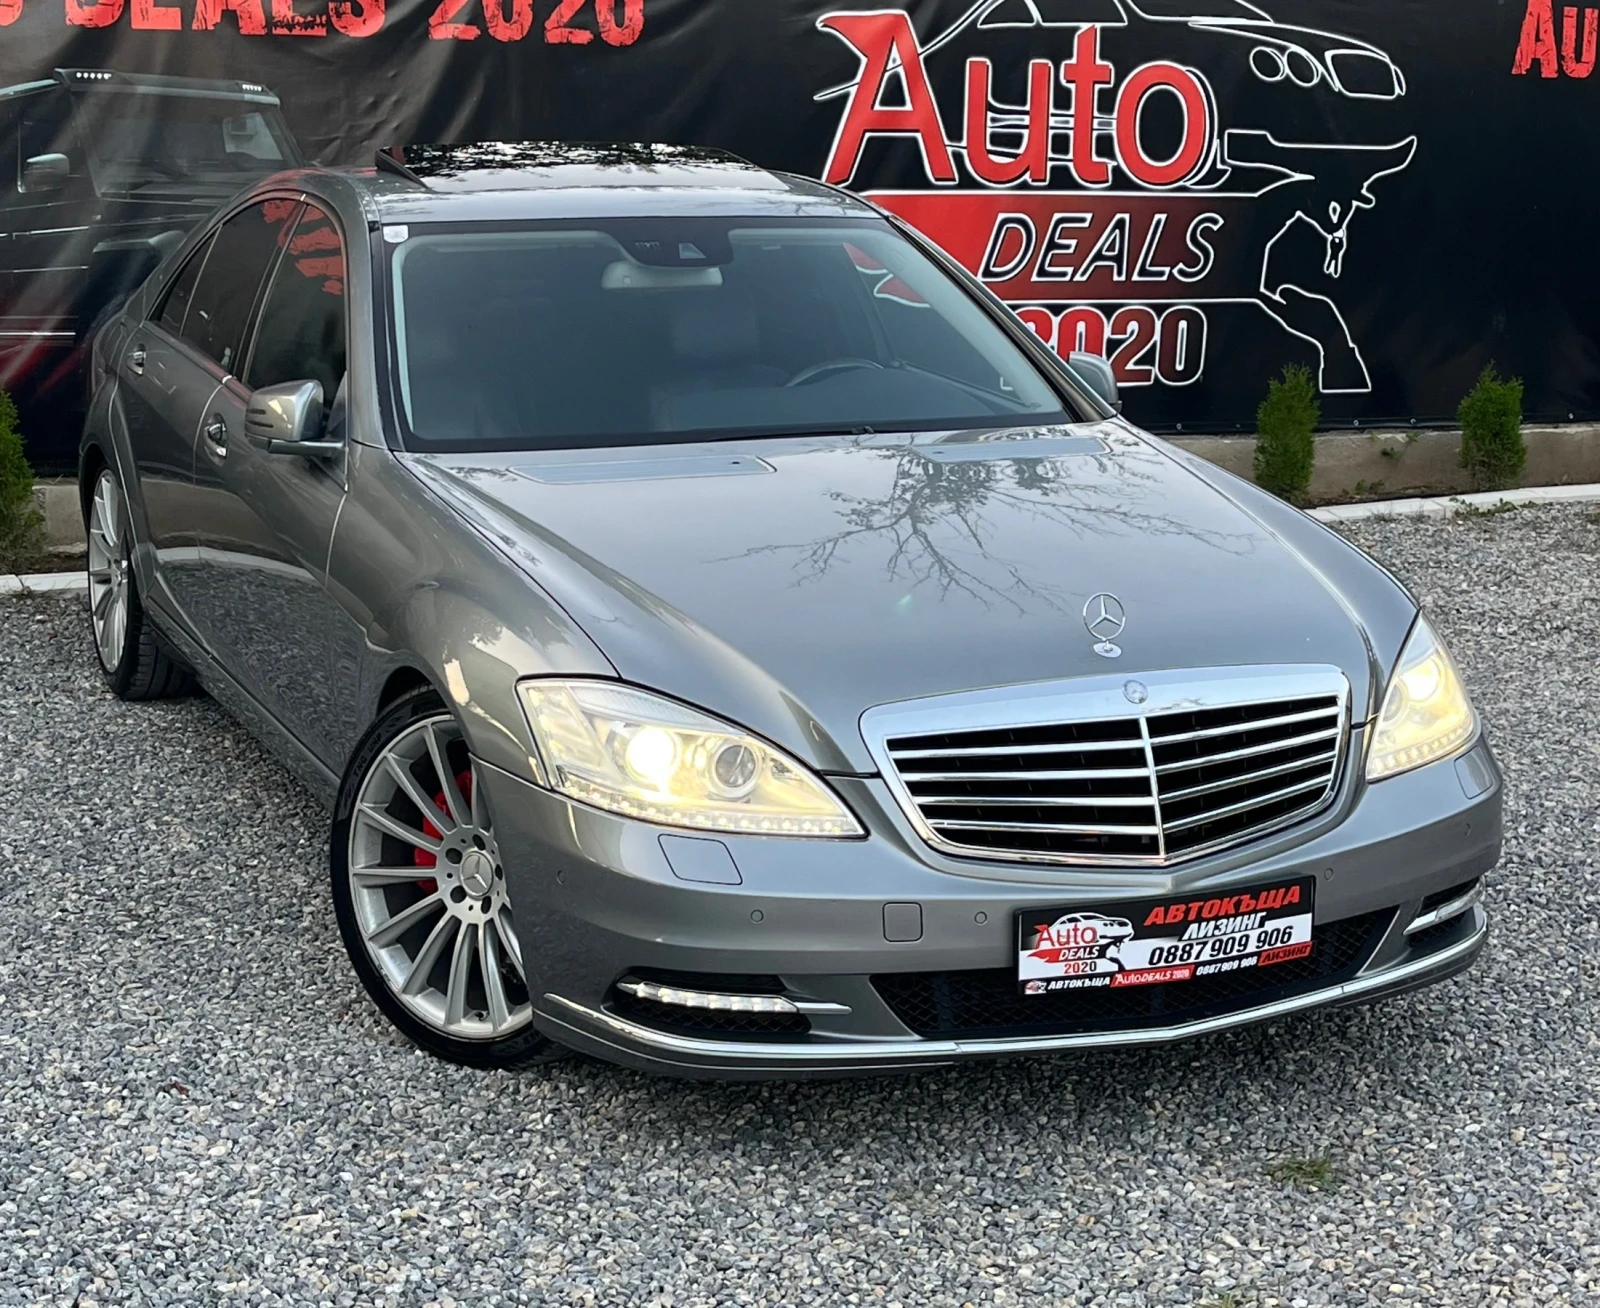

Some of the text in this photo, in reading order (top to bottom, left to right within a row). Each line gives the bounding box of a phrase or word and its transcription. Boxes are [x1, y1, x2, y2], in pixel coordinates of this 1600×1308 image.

[816, 9, 1211, 188] Auto
[976, 212, 1224, 282] DEALS
[1143, 885, 1301, 926] АВТОКЪЩА
[1033, 922, 1097, 949] Auto
[1181, 912, 1267, 940] ЛИЗИНГ
[1255, 925, 1294, 949] 906
[1058, 946, 1100, 961] DEALS
[1064, 961, 1097, 974] 2020
